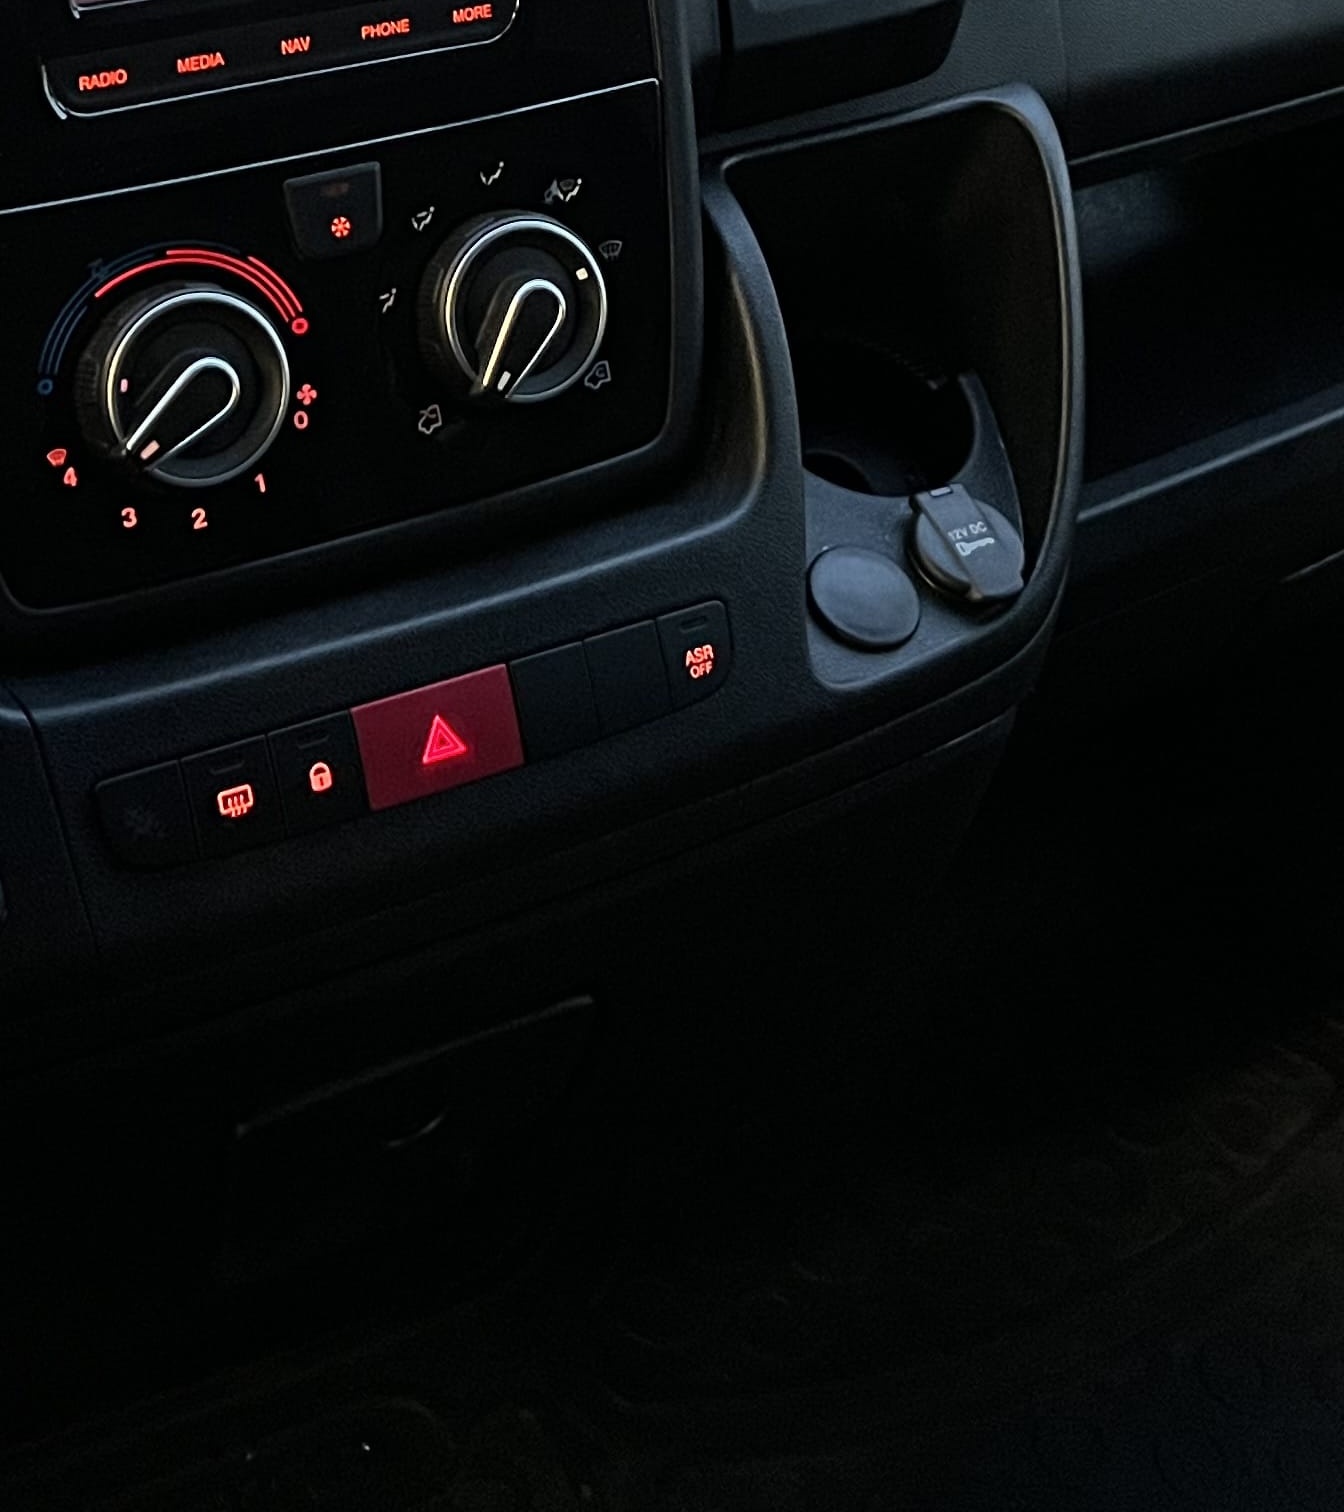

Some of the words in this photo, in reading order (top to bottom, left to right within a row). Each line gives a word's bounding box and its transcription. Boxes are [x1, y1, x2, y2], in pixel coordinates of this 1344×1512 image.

[452, 3, 493, 23] MORE
[360, 18, 410, 40] PHONE
[280, 35, 311, 55] NAV
[176, 51, 225, 74] MEDIA
[78, 68, 128, 91] RADIO
[293, 410, 309, 430] 0
[63, 466, 78, 487] 4
[254, 473, 266, 493] 1
[121, 507, 138, 528] 3
[191, 508, 208, 530] 2
[947, 527, 968, 541] 12V
[968, 520, 988, 535] DC
[686, 644, 714, 667] ASR
[689, 660, 713, 679] OFF
